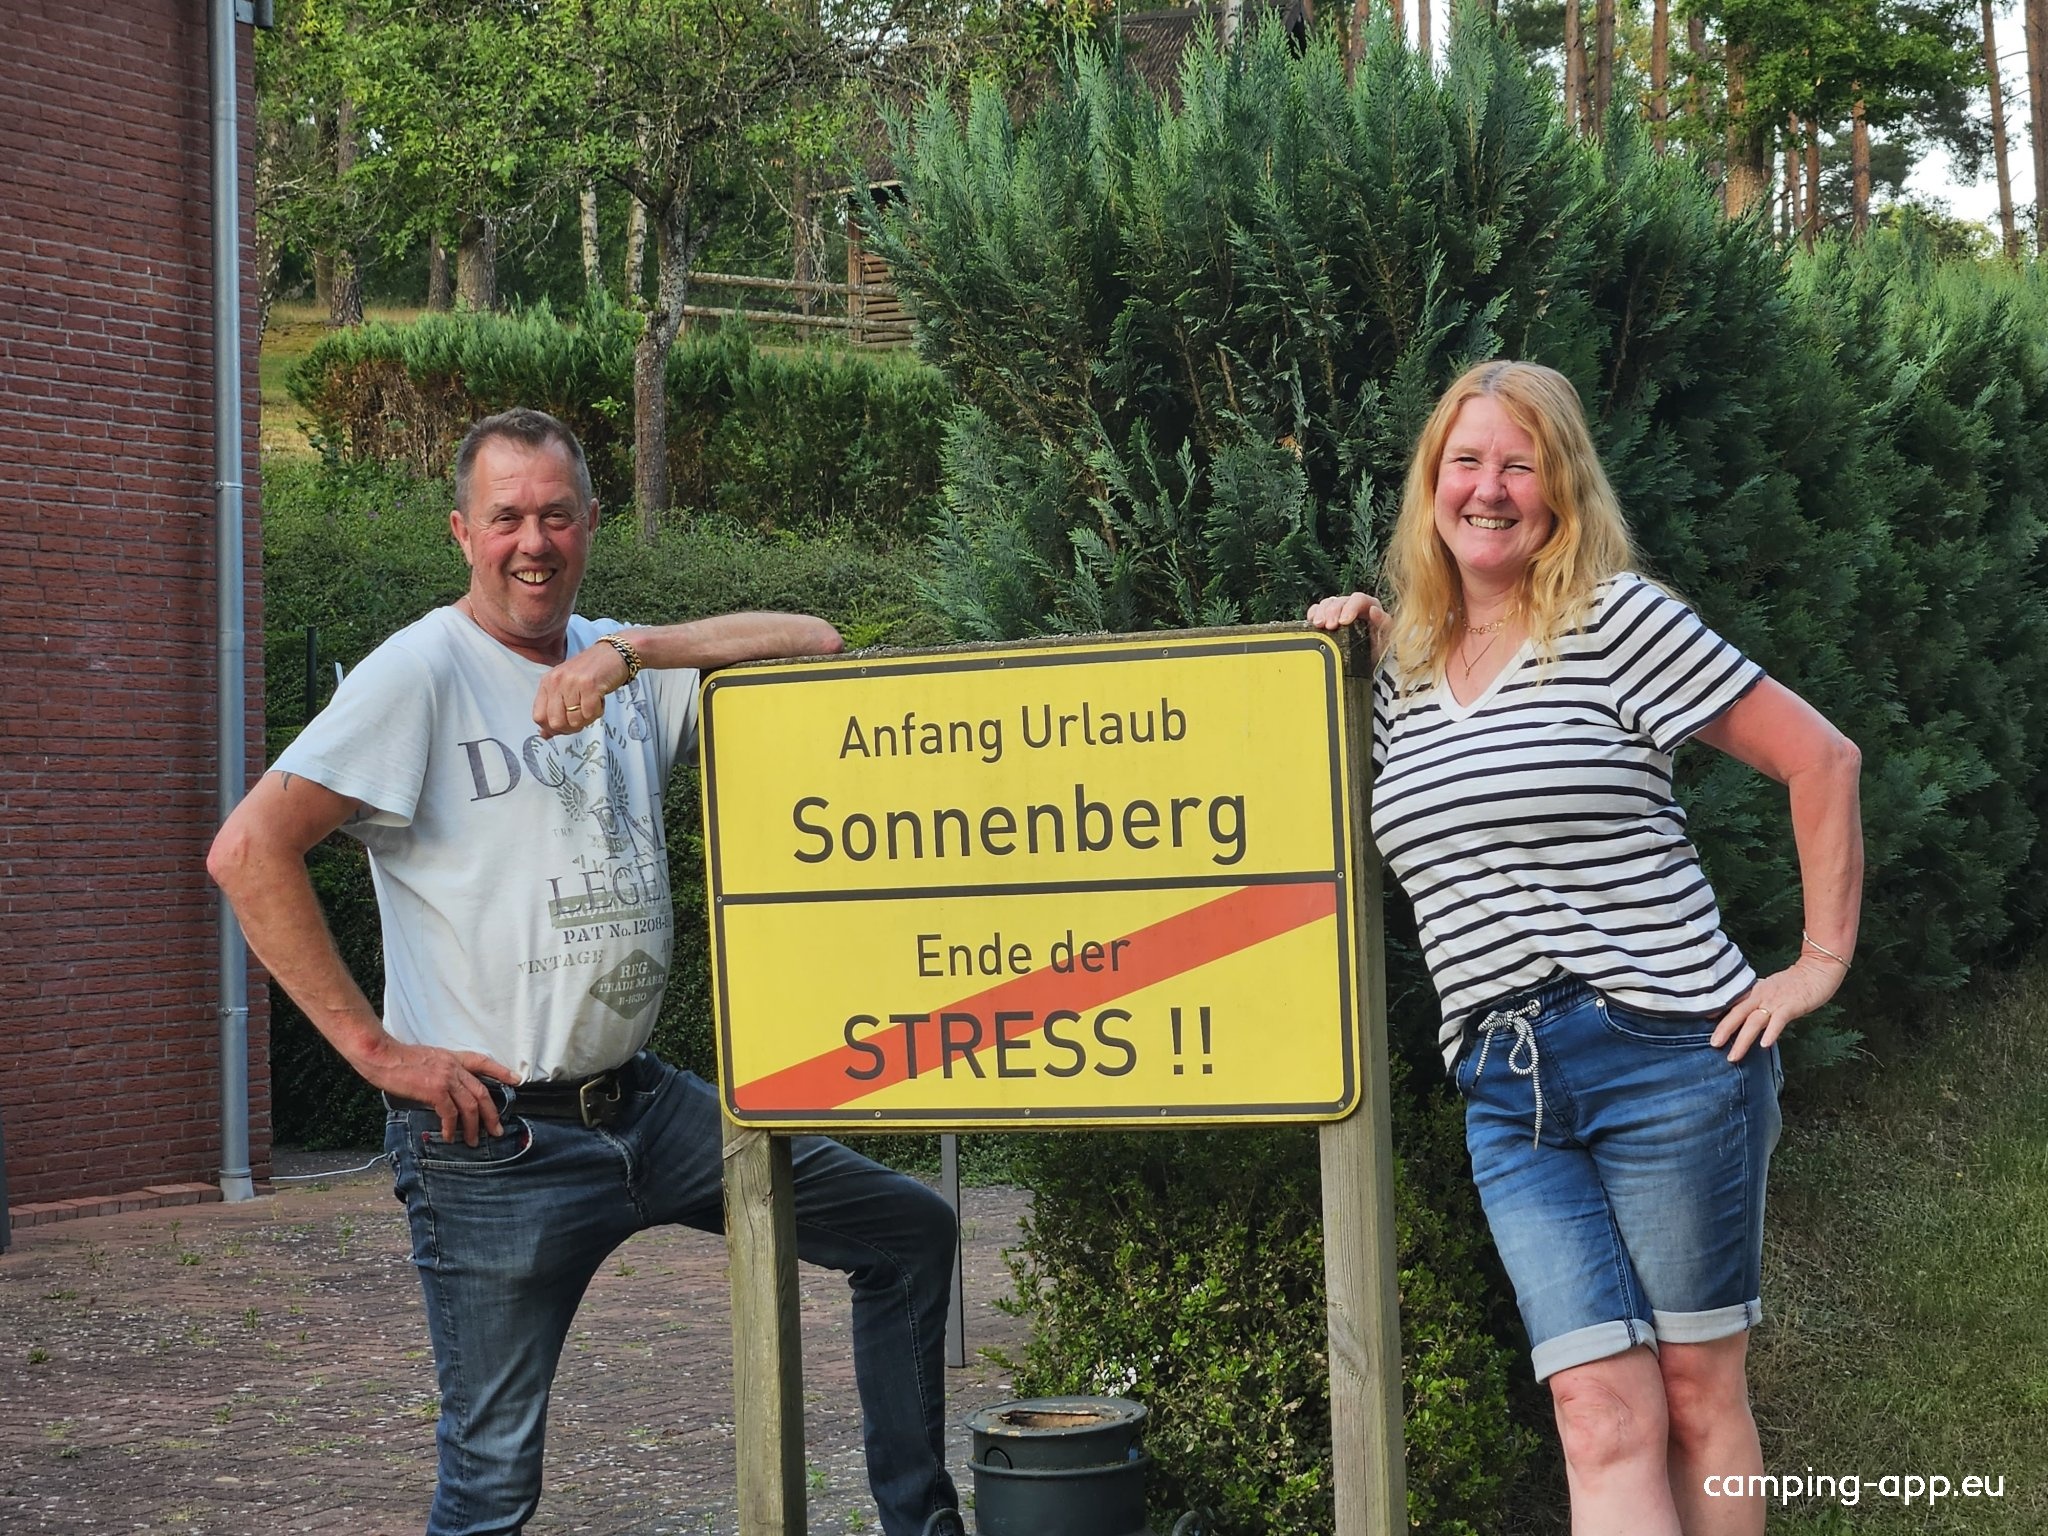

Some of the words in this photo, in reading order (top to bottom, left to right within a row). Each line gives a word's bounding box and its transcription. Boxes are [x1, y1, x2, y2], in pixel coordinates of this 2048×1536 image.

[839, 709, 1003, 764] Anfang
[1022, 697, 1187, 749] Urlaub
[793, 784, 1247, 866] Sonnenberg
[518, 949, 604, 975] VINTAGE
[563, 925, 604, 945] PAT
[917, 932, 1035, 977] Ende
[1050, 930, 1128, 973] der
[844, 1008, 1137, 1080] STRESS
[1170, 1006, 1213, 1076] !!
